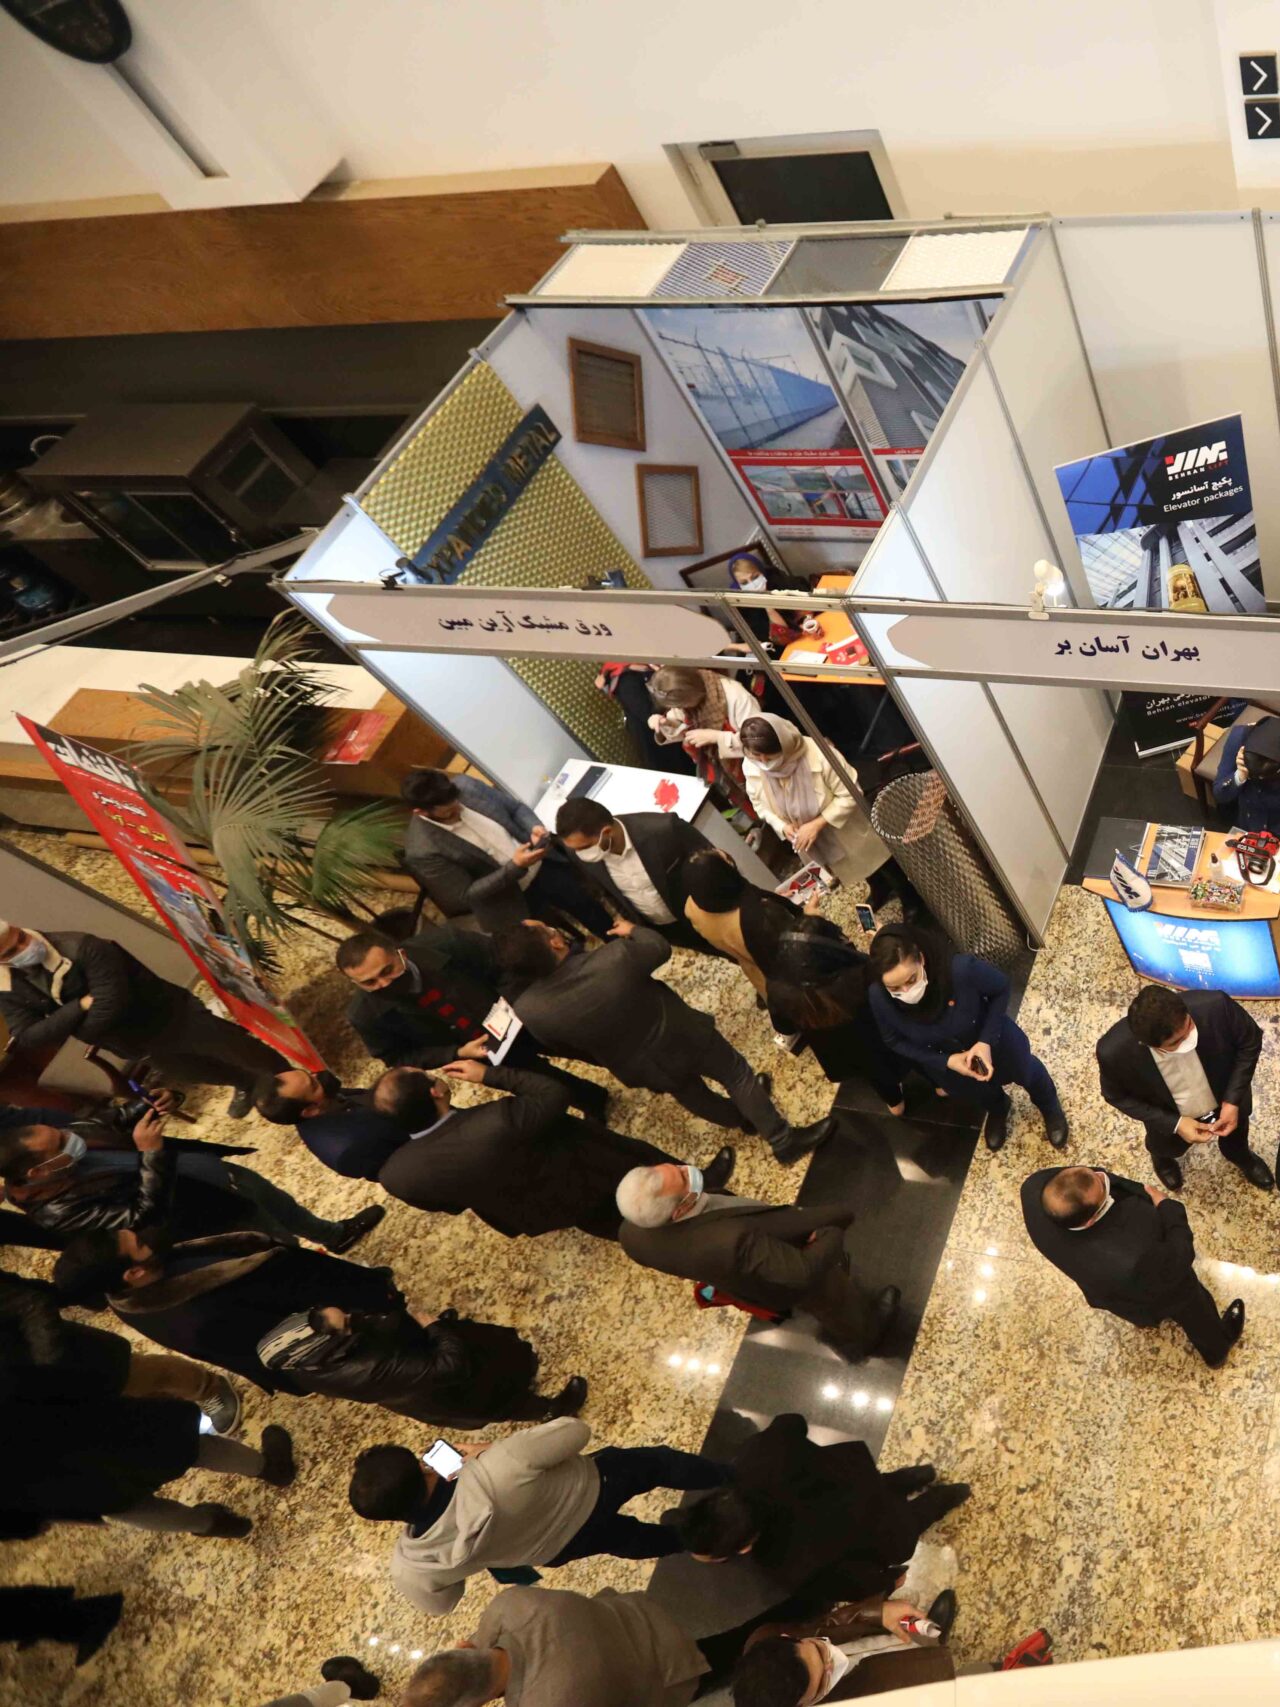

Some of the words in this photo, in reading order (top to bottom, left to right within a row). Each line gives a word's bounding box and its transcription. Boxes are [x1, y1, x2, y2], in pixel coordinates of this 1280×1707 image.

[1168, 467, 1205, 481] BEHRAN
[1171, 481, 1209, 500] آسانسور
[1212, 476, 1232, 491] پکیج
[1163, 498, 1200, 512] Elevator
[1203, 486, 1244, 503] packages
[438, 617, 474, 631] مبین
[479, 610, 516, 632] آرین
[517, 615, 570, 633] مشبک
[575, 618, 613, 636] ورق
[1054, 639, 1073, 655] بر
[1079, 635, 1131, 657] آسان
[1142, 640, 1201, 662] بهران
[1146, 703, 1175, 716] Behran
